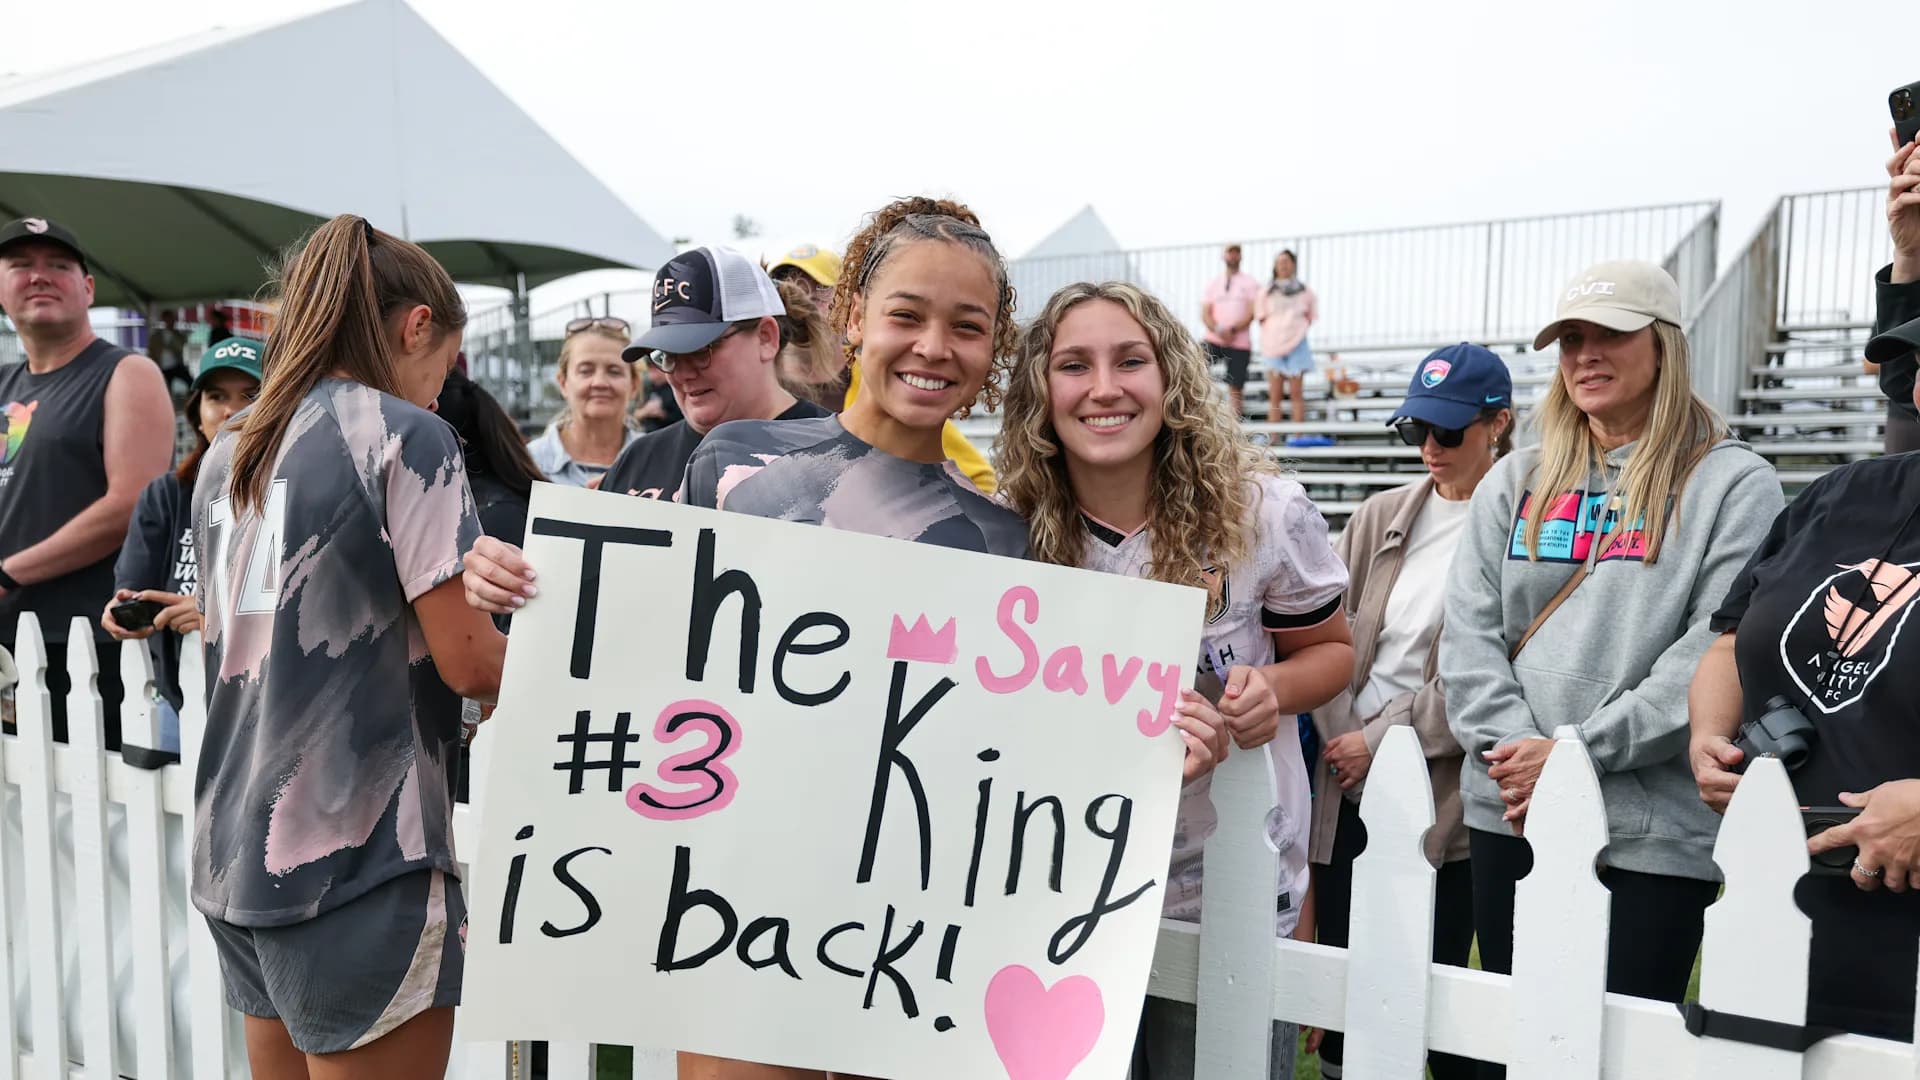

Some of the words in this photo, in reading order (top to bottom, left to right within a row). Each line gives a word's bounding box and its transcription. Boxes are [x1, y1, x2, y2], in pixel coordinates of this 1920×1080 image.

[208, 479, 288, 655] 14
[532, 517, 851, 706] The
[976, 586, 1180, 737] Savy
[1816, 671, 1858, 690] ITY
[1824, 689, 1841, 700] FC
[553, 699, 742, 821] #3
[856, 660, 1155, 966] King
[499, 825, 612, 944] is
[651, 846, 961, 1032] back!
